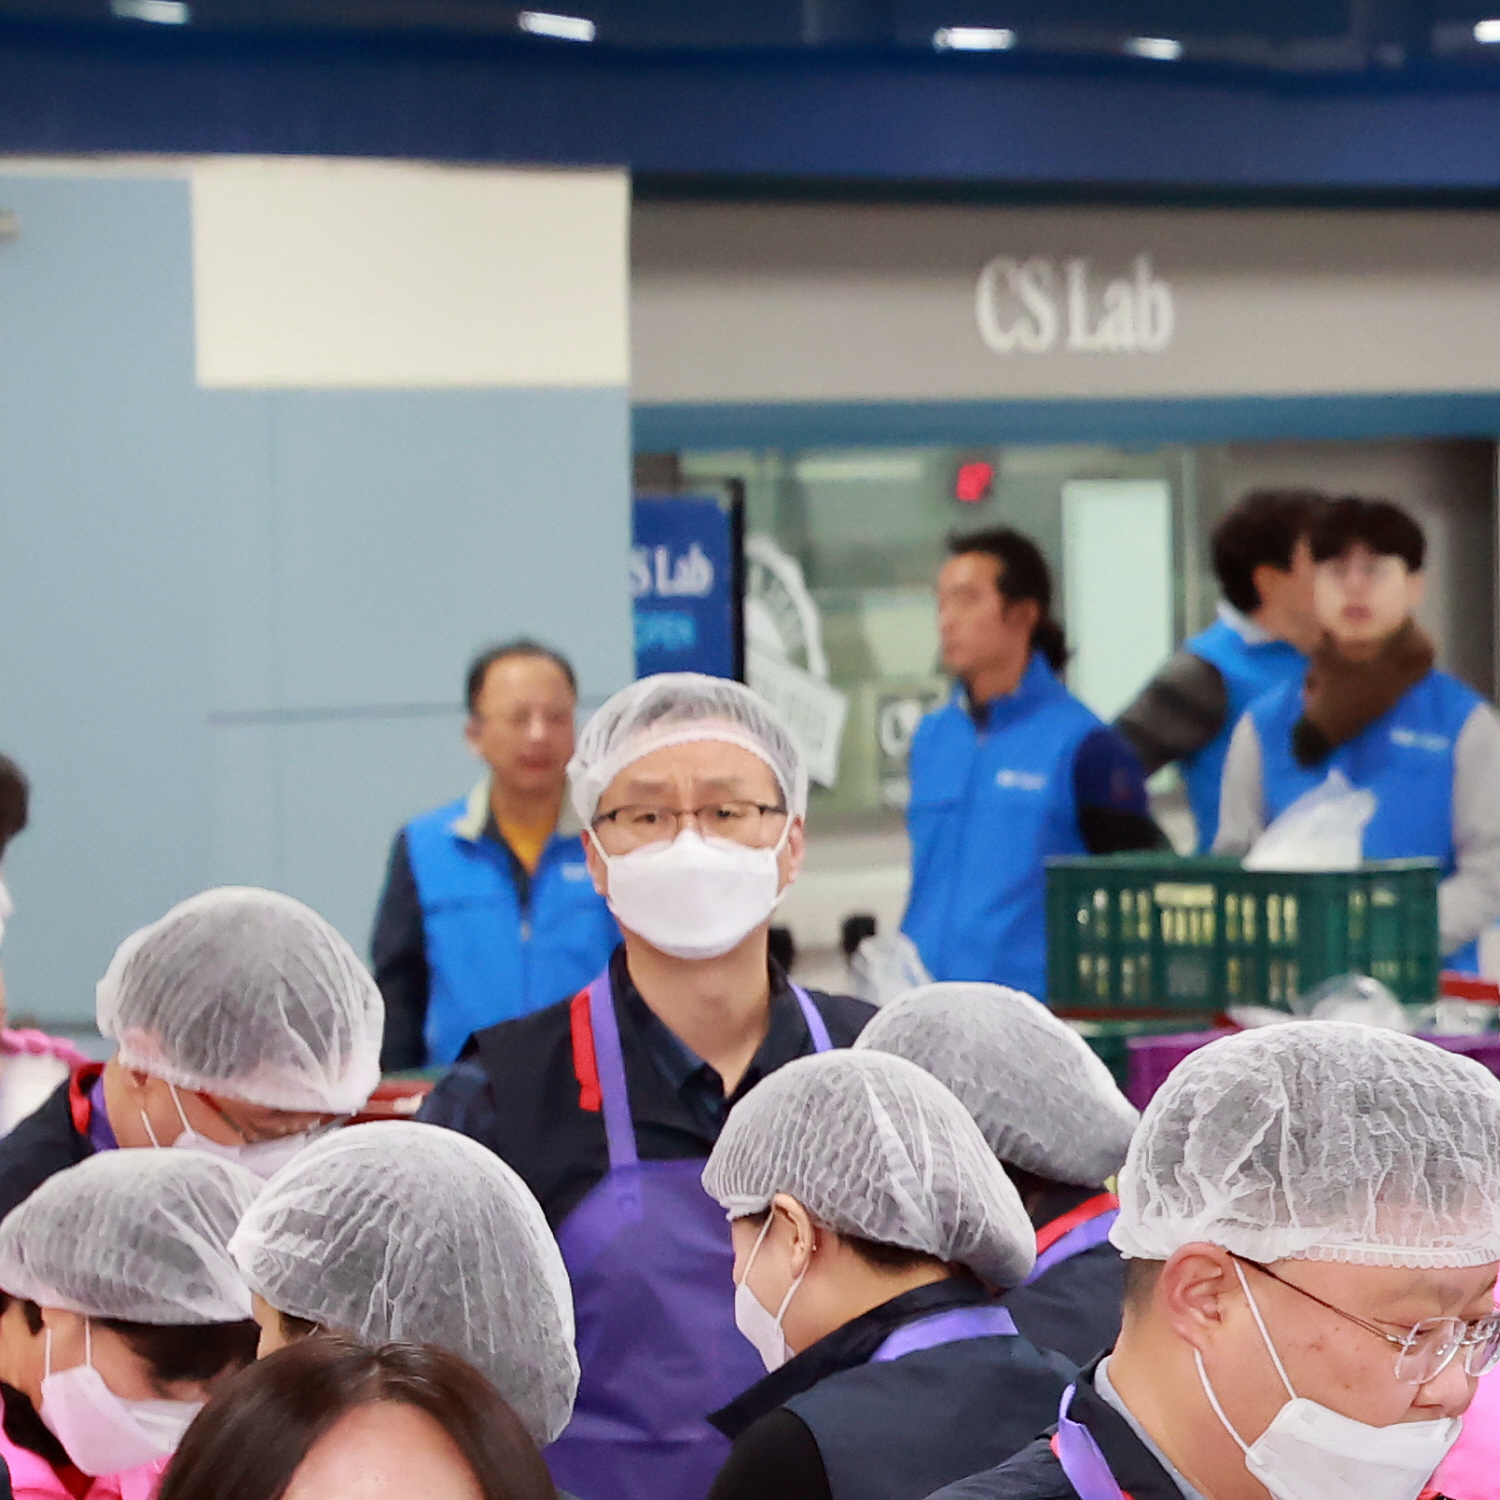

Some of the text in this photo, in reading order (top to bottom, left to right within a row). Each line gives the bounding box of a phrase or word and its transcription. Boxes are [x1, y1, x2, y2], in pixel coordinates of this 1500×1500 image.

[975, 250, 1175, 353] CS Lab
[632, 541, 715, 598] S Lab
